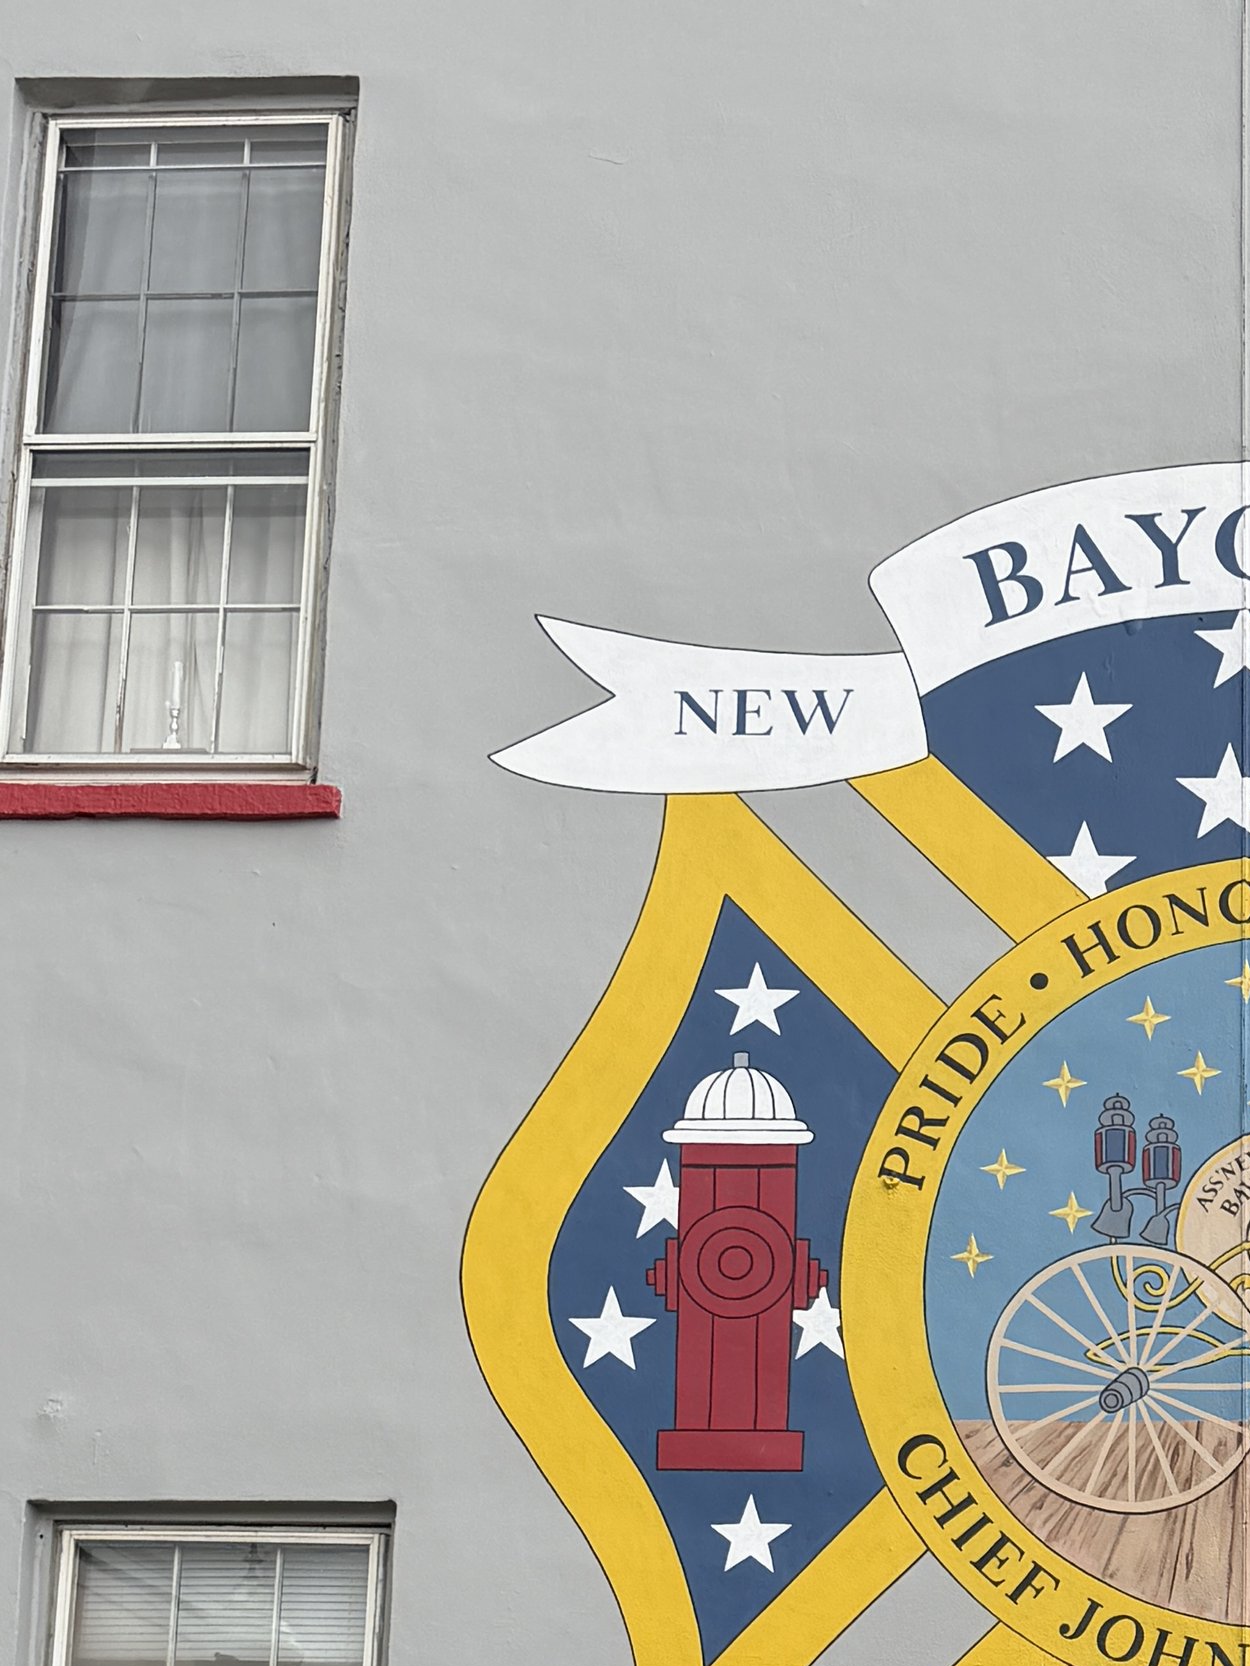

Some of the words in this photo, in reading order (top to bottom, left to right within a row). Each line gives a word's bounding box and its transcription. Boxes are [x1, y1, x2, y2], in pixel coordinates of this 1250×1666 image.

[673, 688, 855, 736] NEW
[877, 994, 1026, 1191] PRIDE
[897, 1433, 1061, 1606] CHIEF
